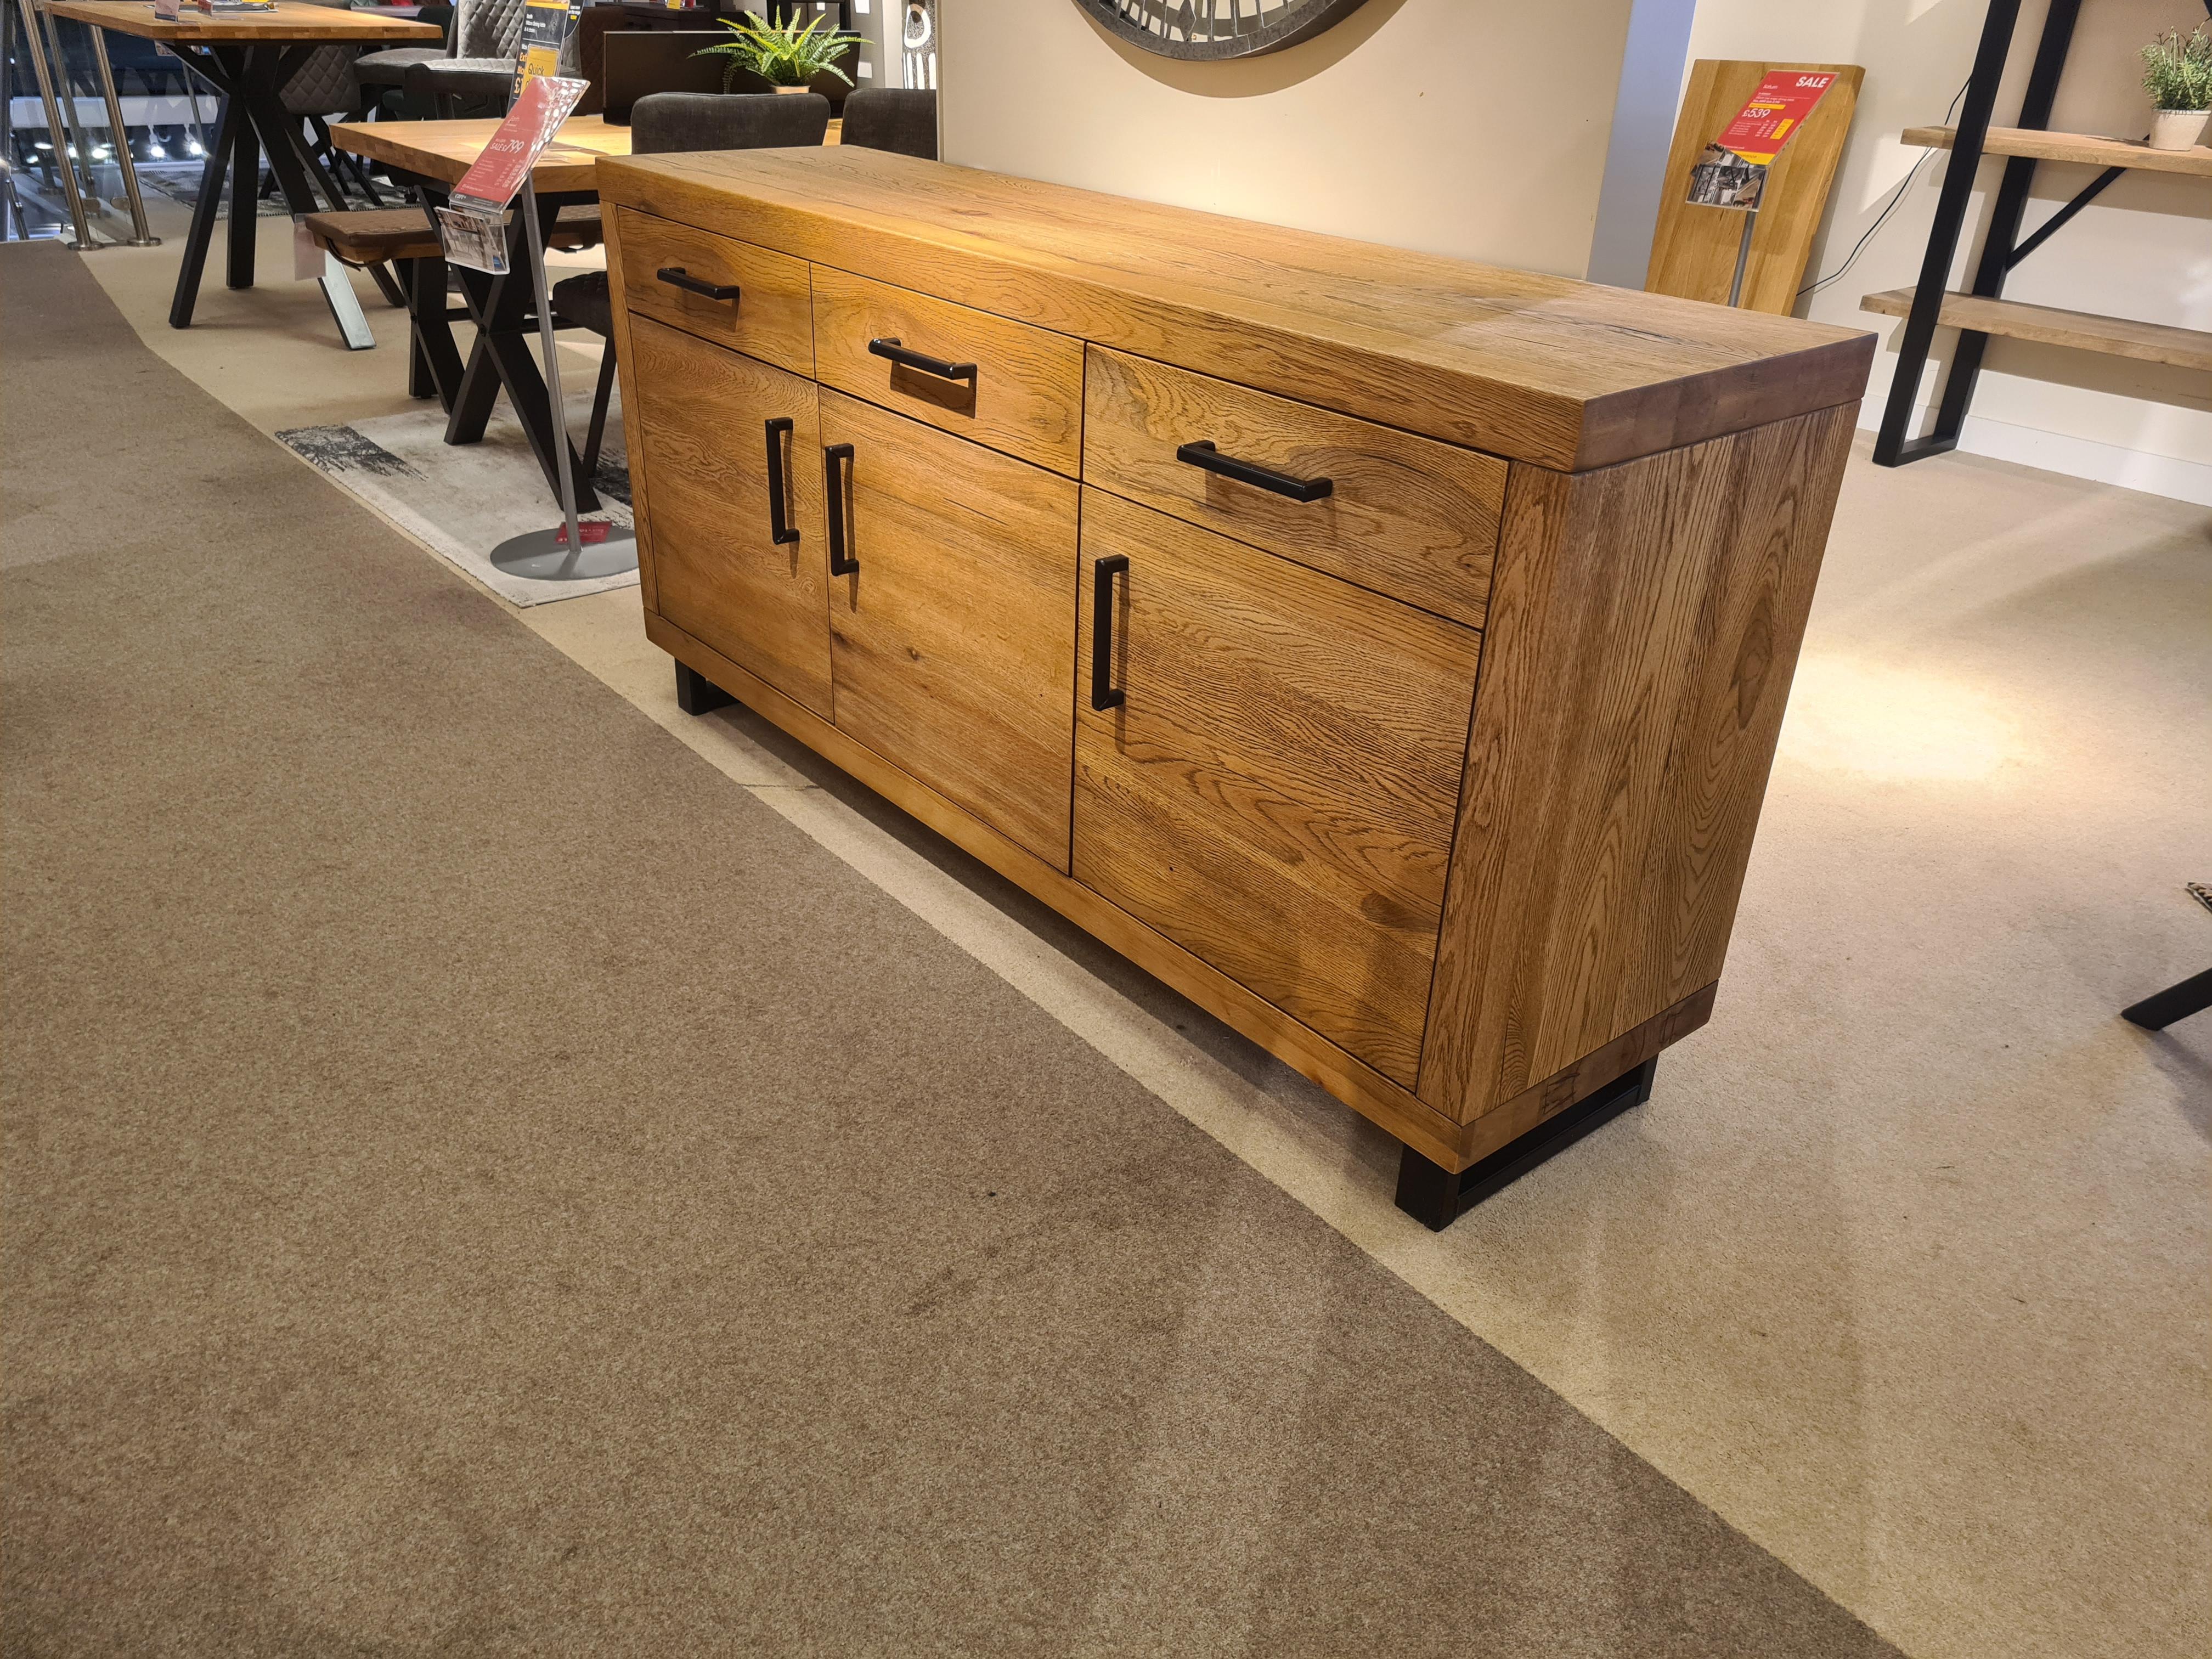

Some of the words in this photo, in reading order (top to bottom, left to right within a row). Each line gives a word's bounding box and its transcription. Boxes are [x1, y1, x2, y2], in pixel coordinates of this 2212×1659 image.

[528, 63, 545, 76] Quick
[1796, 76, 1830, 88] SALE
[1742, 108, 1771, 119] £539
